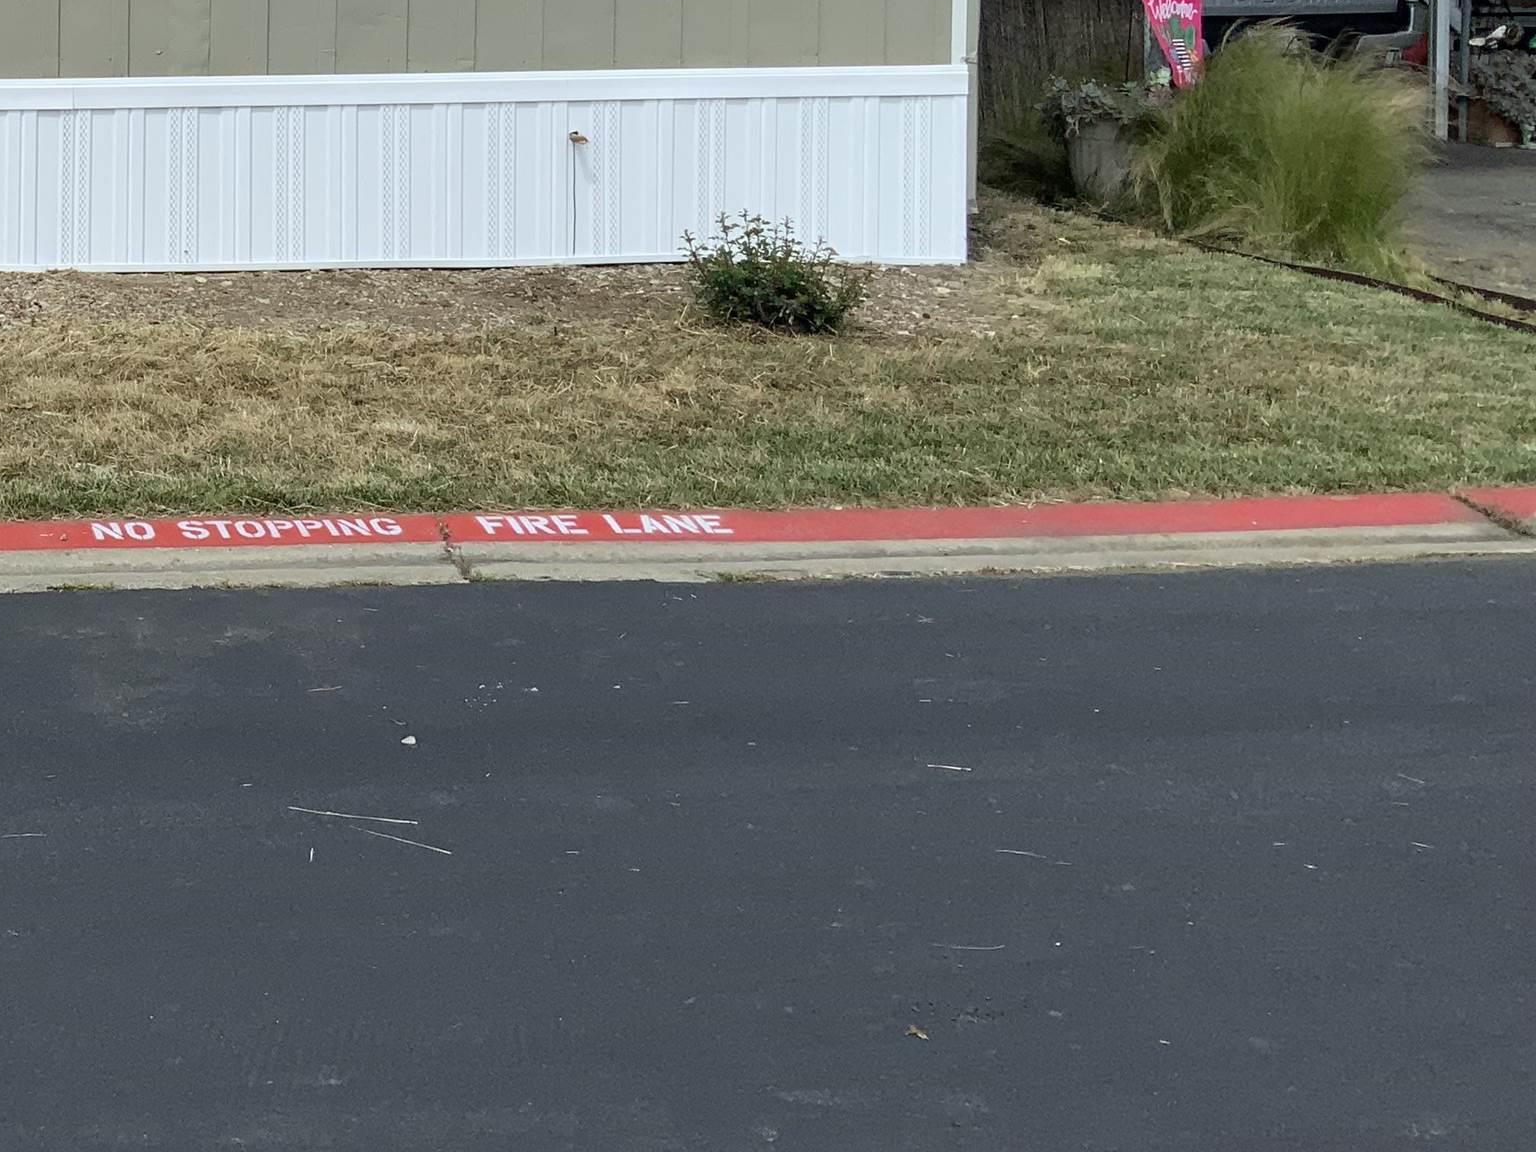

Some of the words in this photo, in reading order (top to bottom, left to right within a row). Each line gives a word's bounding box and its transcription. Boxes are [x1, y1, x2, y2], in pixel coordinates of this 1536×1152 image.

[90, 521, 156, 541] NO
[177, 518, 402, 540] STOPPING
[474, 514, 590, 535] FIRE
[602, 514, 734, 534] LANE
